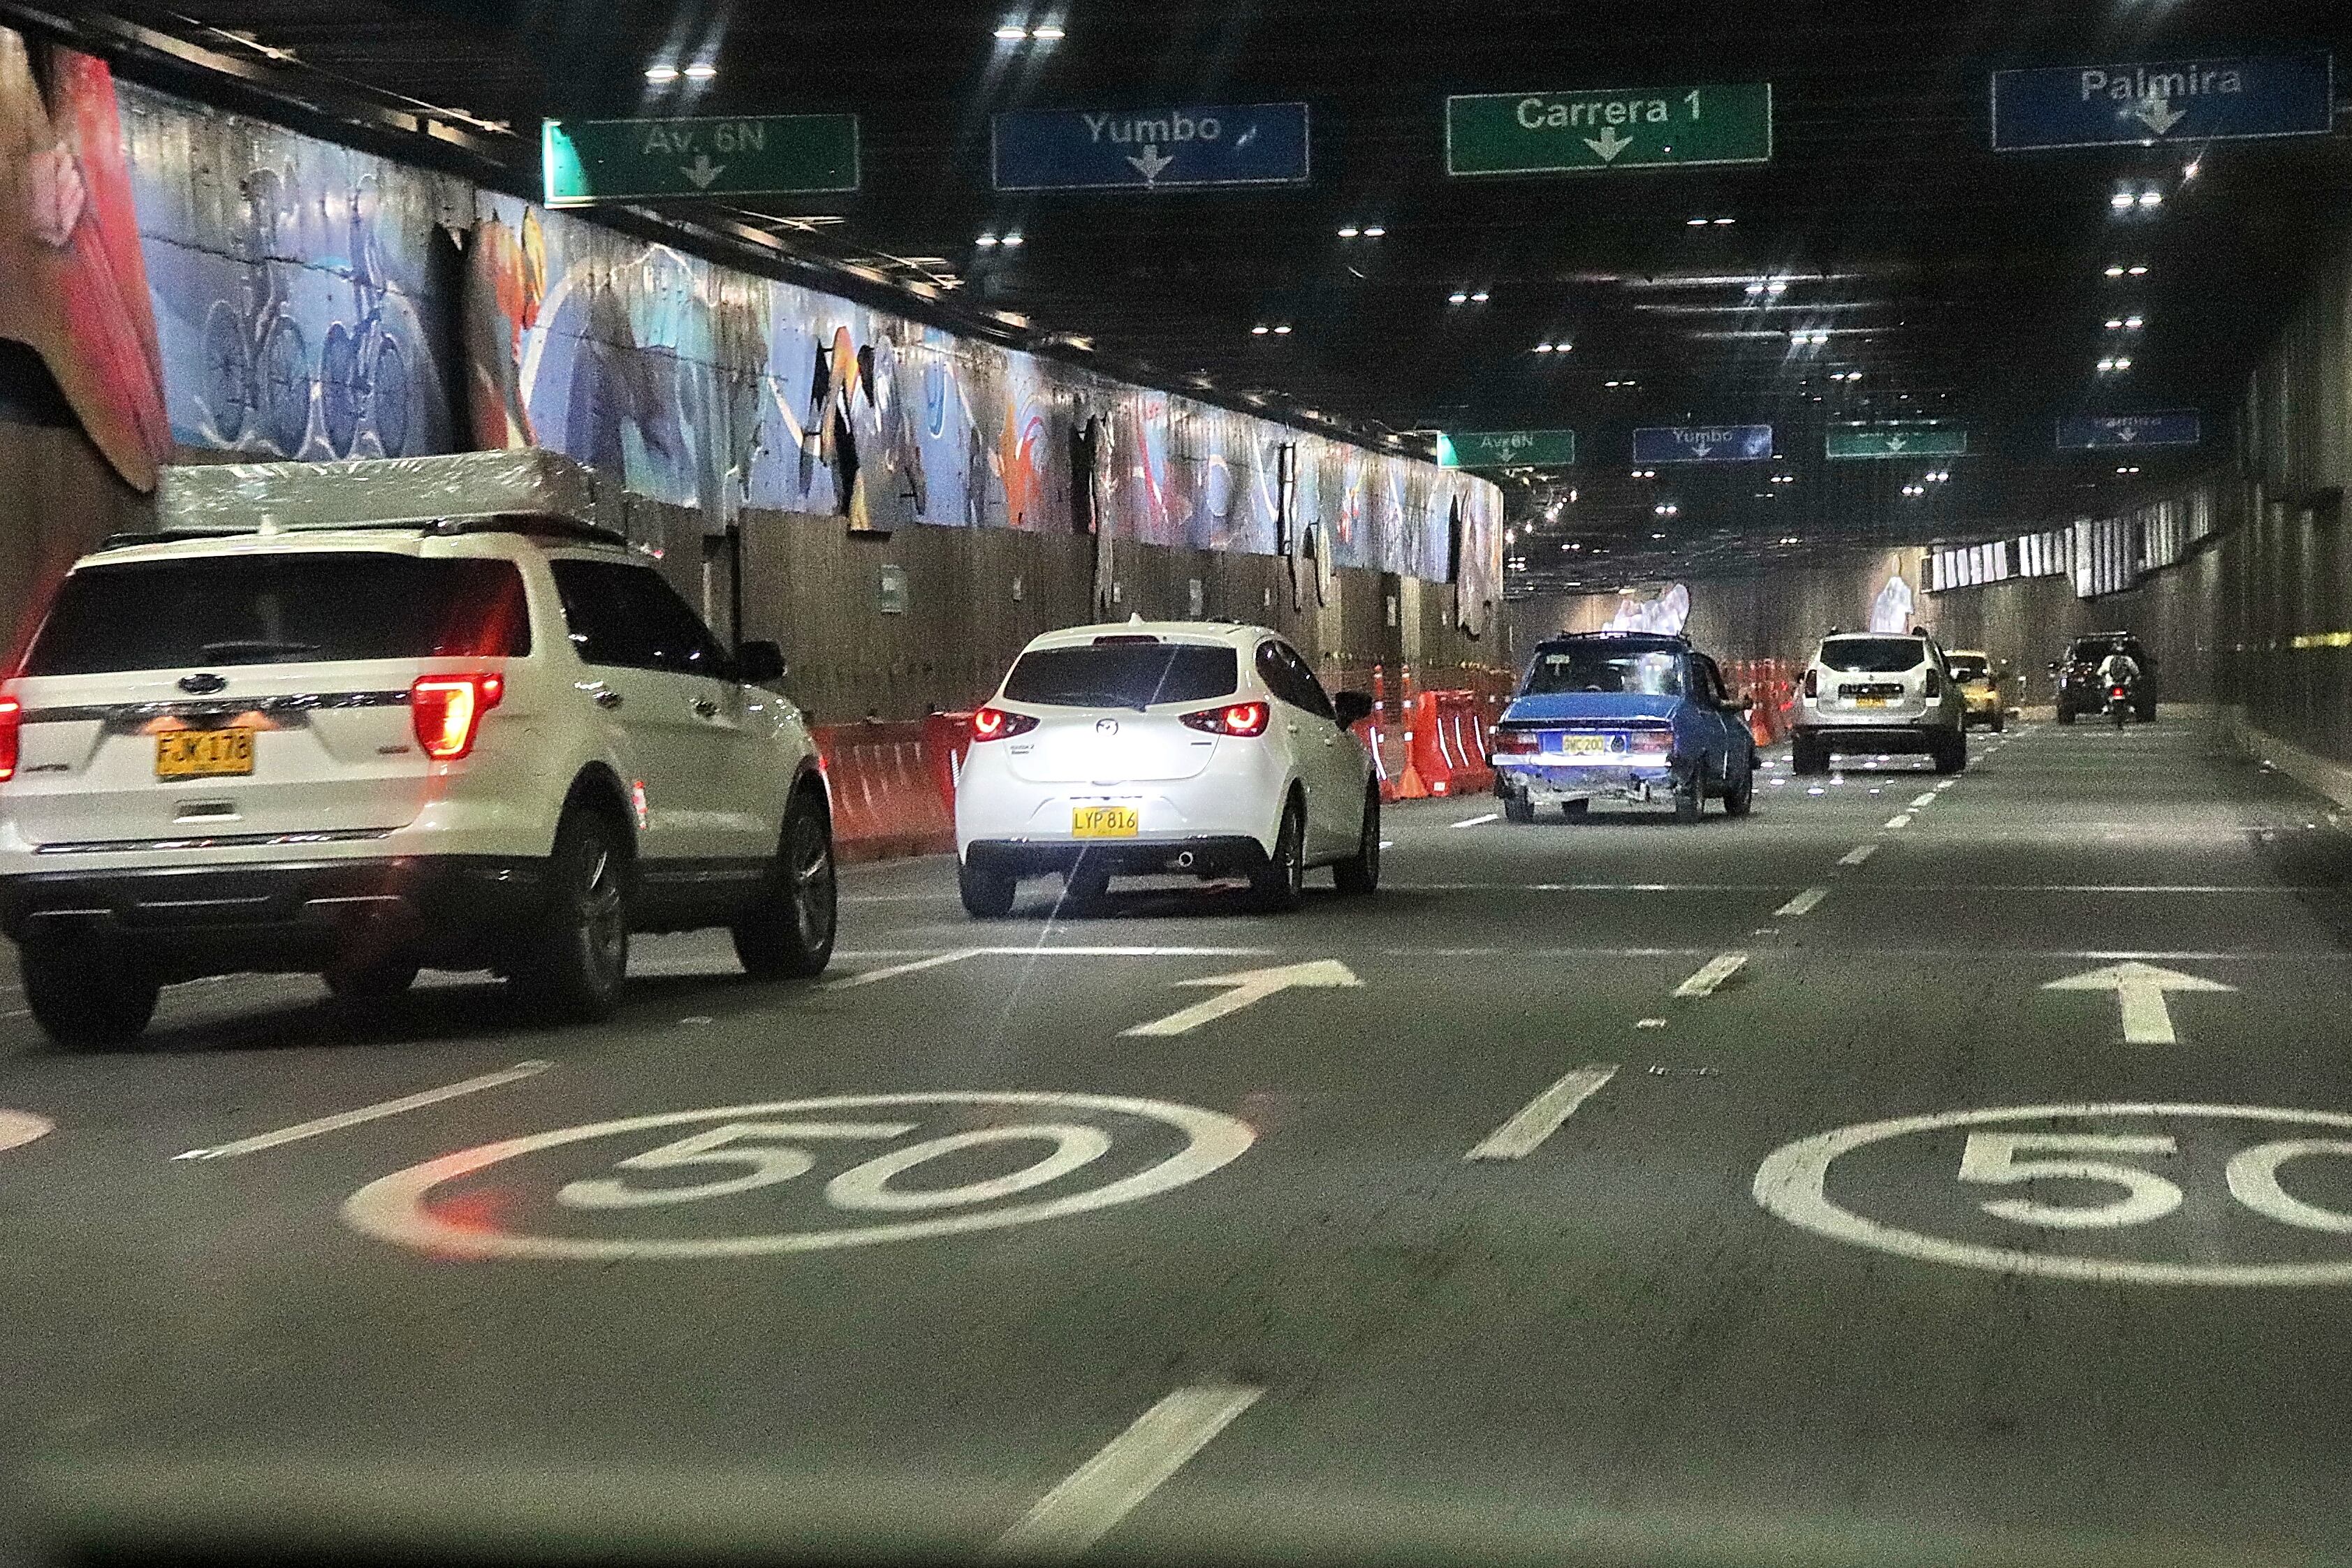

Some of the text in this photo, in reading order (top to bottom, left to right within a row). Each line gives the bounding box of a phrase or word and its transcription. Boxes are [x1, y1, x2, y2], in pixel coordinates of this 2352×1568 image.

[2080, 64, 2242, 101] Palmira
[1517, 89, 1700, 129] Carrera 1
[643, 122, 764, 154] Av. 6N
[1082, 111, 1221, 143] Yumbo
[1672, 430, 1733, 444] Yumbo
[209, 734, 249, 761] 178
[1074, 811, 1136, 829] LYP 816
[556, 1120, 1113, 1211] 50
